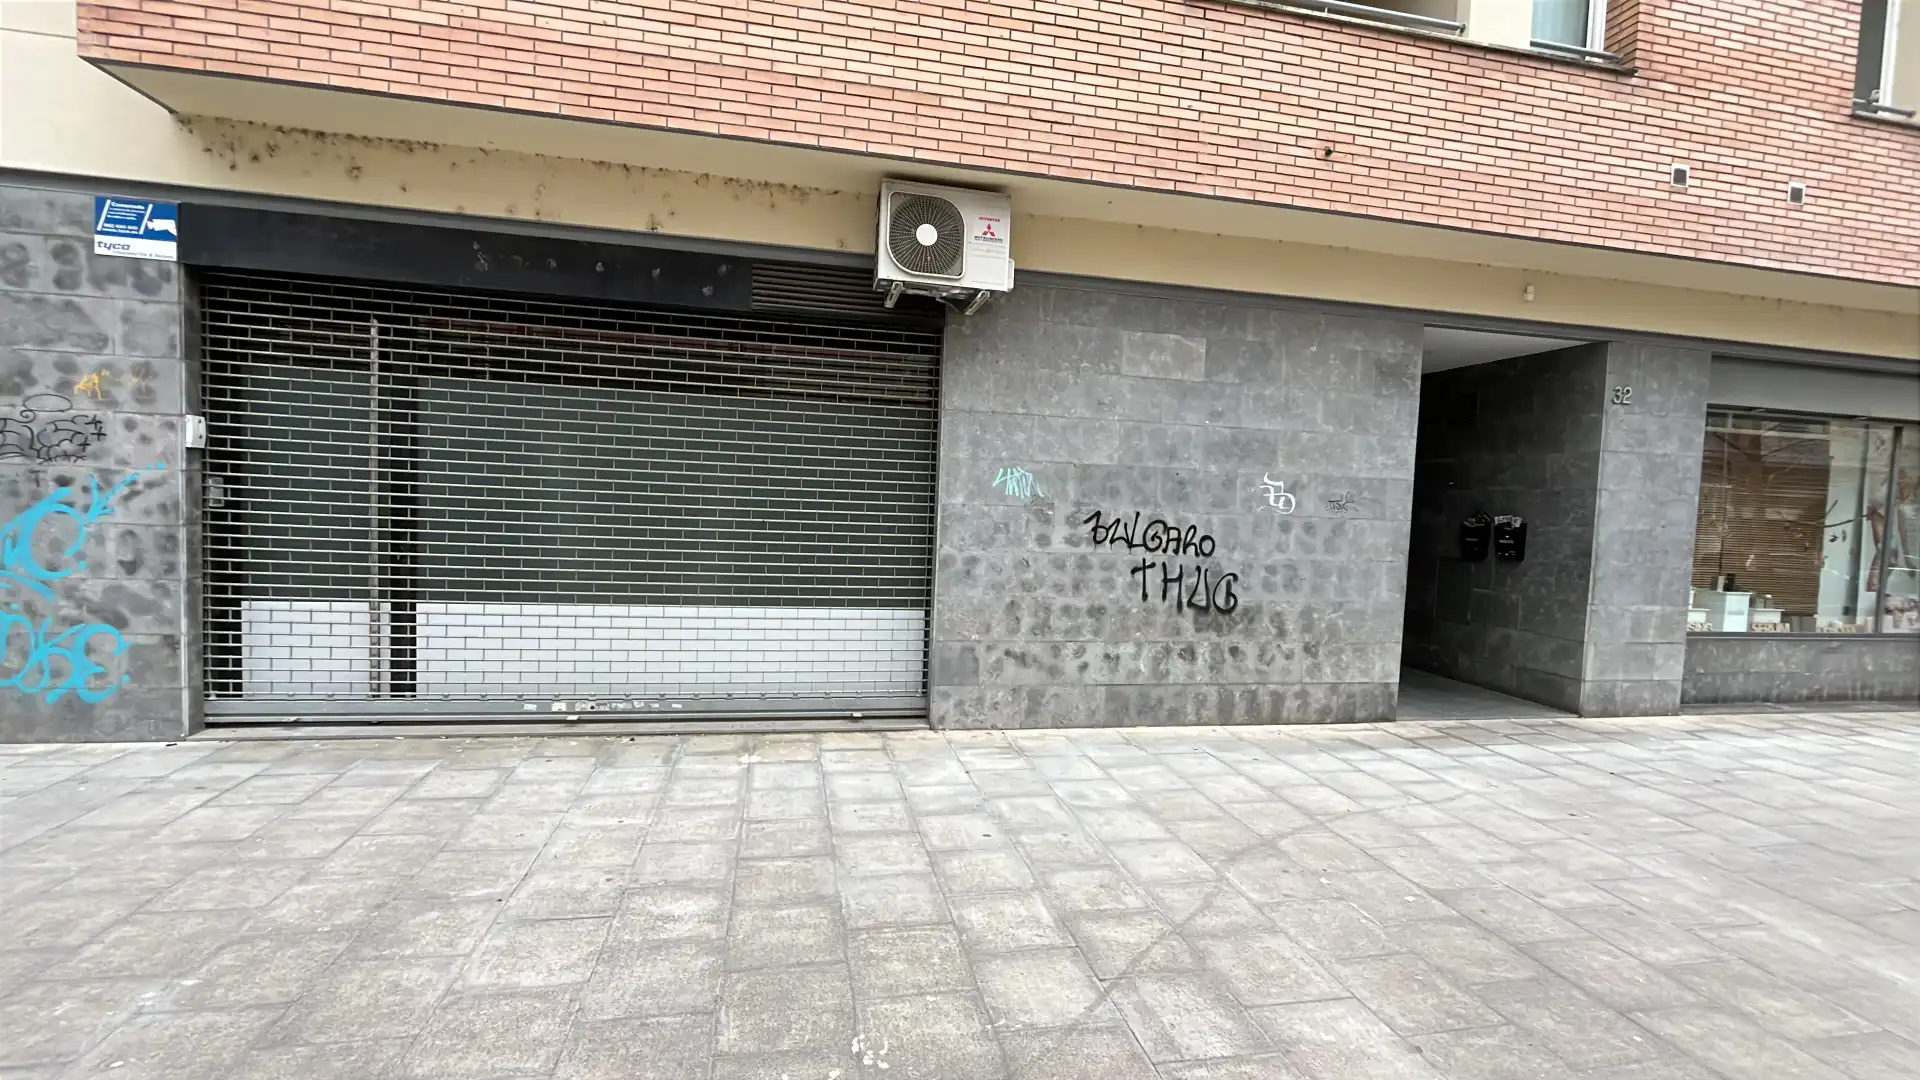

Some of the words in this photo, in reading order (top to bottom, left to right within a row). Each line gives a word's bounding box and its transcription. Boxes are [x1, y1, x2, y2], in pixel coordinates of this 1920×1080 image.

[96, 241, 131, 251] tyco
[1612, 386, 1632, 404] 32
[1130, 557, 1239, 614] THUG
